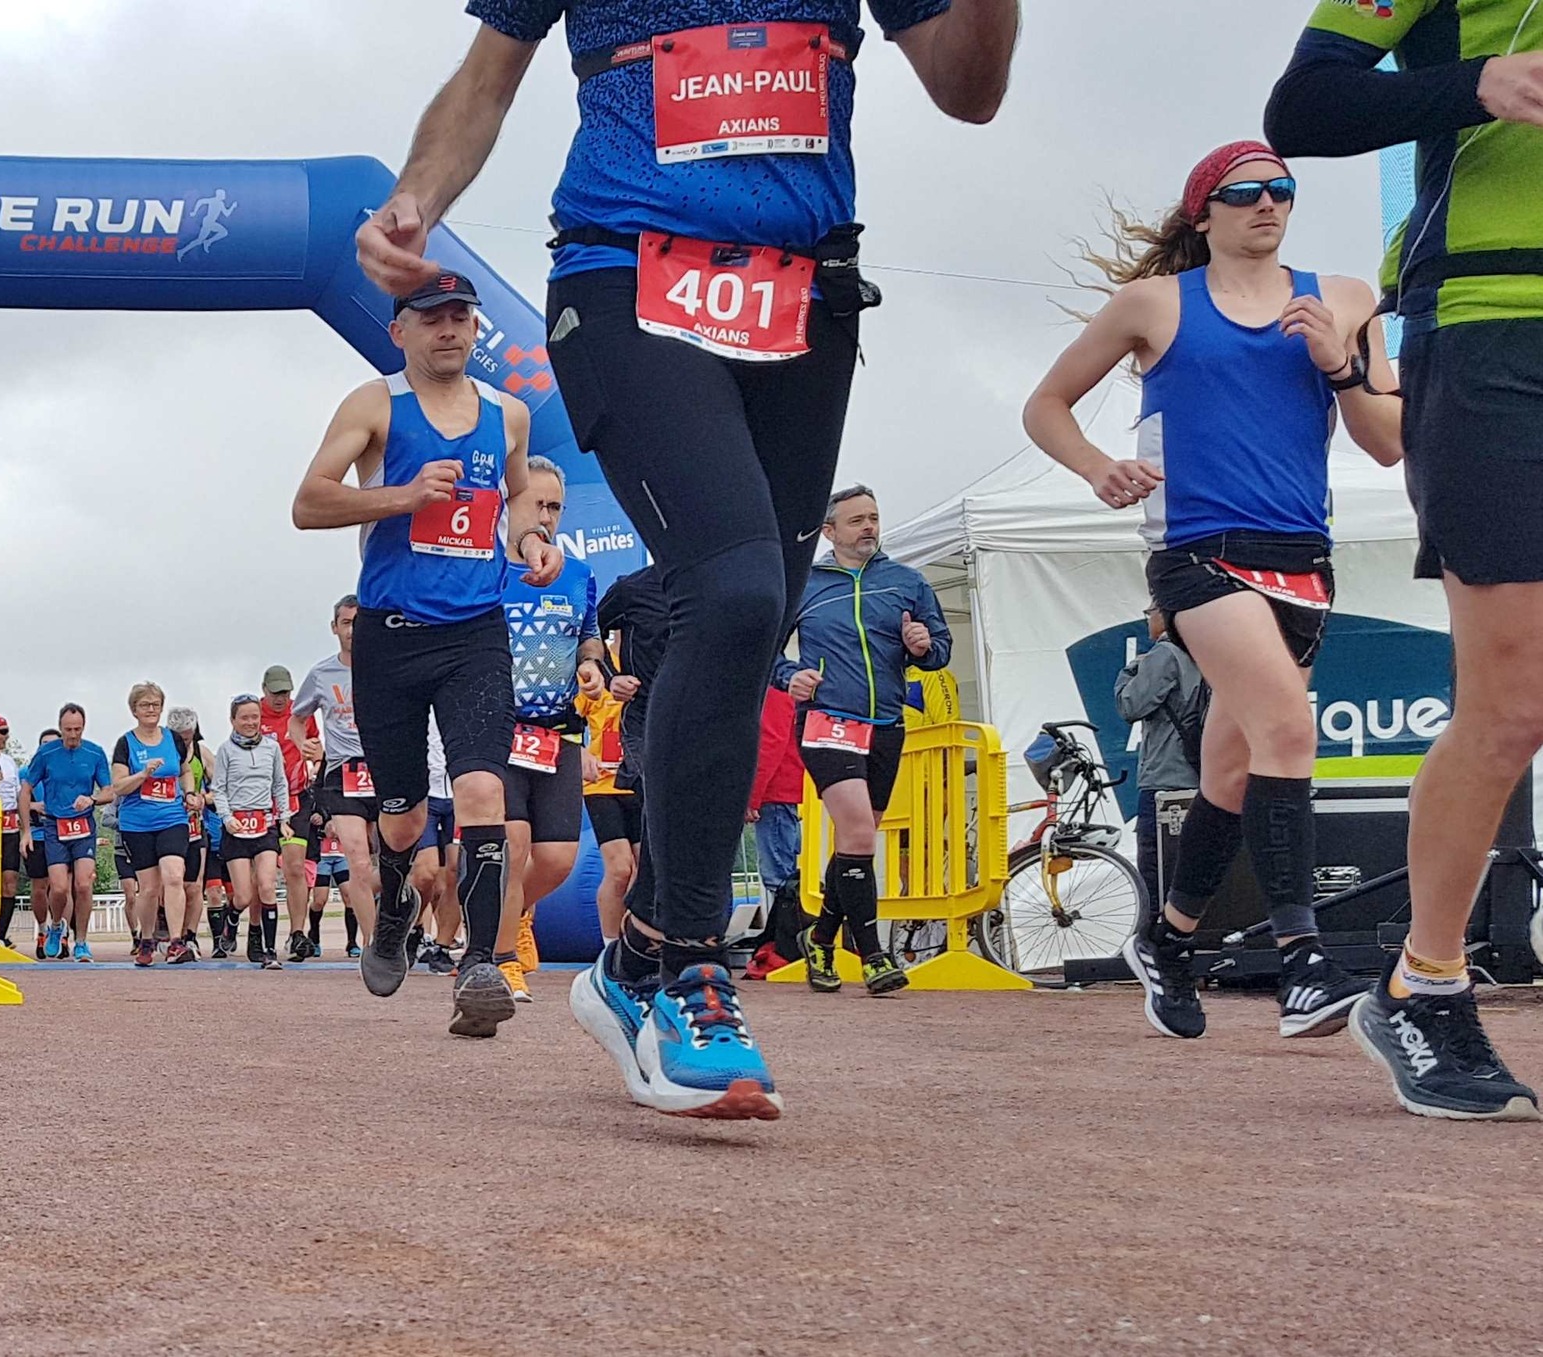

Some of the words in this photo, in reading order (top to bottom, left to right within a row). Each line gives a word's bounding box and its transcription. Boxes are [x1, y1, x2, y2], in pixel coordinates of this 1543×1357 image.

[671, 70, 816, 102] JEAN-PAUL
[718, 117, 780, 135] AXIANS
[52, 198, 185, 235] RUN
[19, 233, 180, 254] CHALLENGE
[666, 269, 774, 330] 401
[694, 322, 750, 345] AXIANS
[451, 506, 470, 535] 6
[592, 526, 610, 535] VILLE
[437, 535, 474, 547] MICKAEL
[556, 529, 635, 560] Nantes
[831, 723, 846, 739] 5
[514, 734, 541, 755] 12
[152, 781, 167, 794] 21
[66, 820, 81, 832] 16
[241, 817, 257, 830] 20
[330, 841, 338, 850] 8
[1388, 1009, 1438, 1078] HOKA
